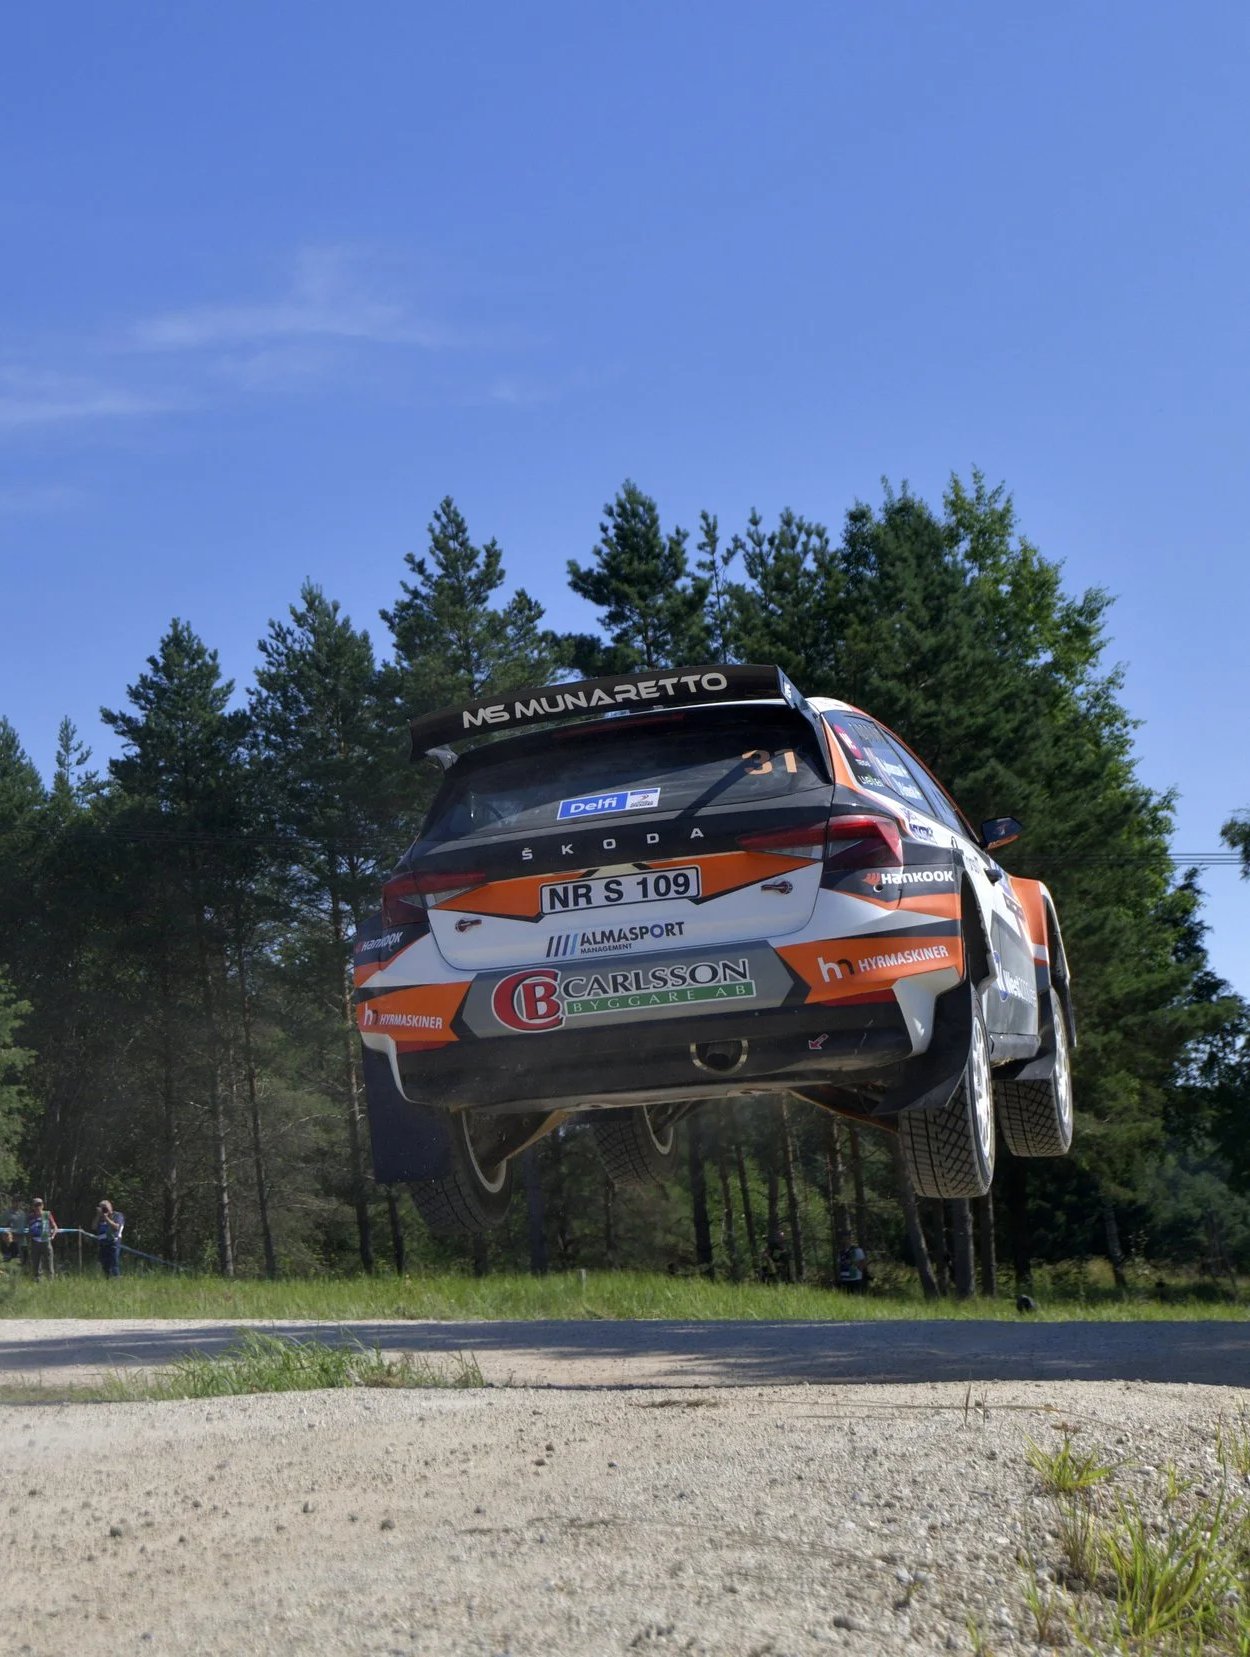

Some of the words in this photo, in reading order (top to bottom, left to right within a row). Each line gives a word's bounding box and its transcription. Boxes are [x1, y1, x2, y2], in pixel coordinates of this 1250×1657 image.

[462, 703, 511, 729] MS
[515, 672, 728, 719] MUNARETTO
[742, 749, 798, 775] 31
[569, 796, 618, 814] Delfi
[521, 827, 705, 861] ŠKODA
[549, 884, 593, 910] NR
[604, 879, 624, 902] S
[636, 872, 691, 899] 109
[579, 921, 685, 947] ALMASPORT
[580, 942, 633, 955] MANAGEMENT
[858, 945, 949, 973] HYRMASKINER
[562, 960, 748, 998] CARLSSON
[573, 990, 695, 1013] BYGGARE
[715, 985, 746, 998] AB
[379, 1013, 443, 1030] HYRMASKINER
